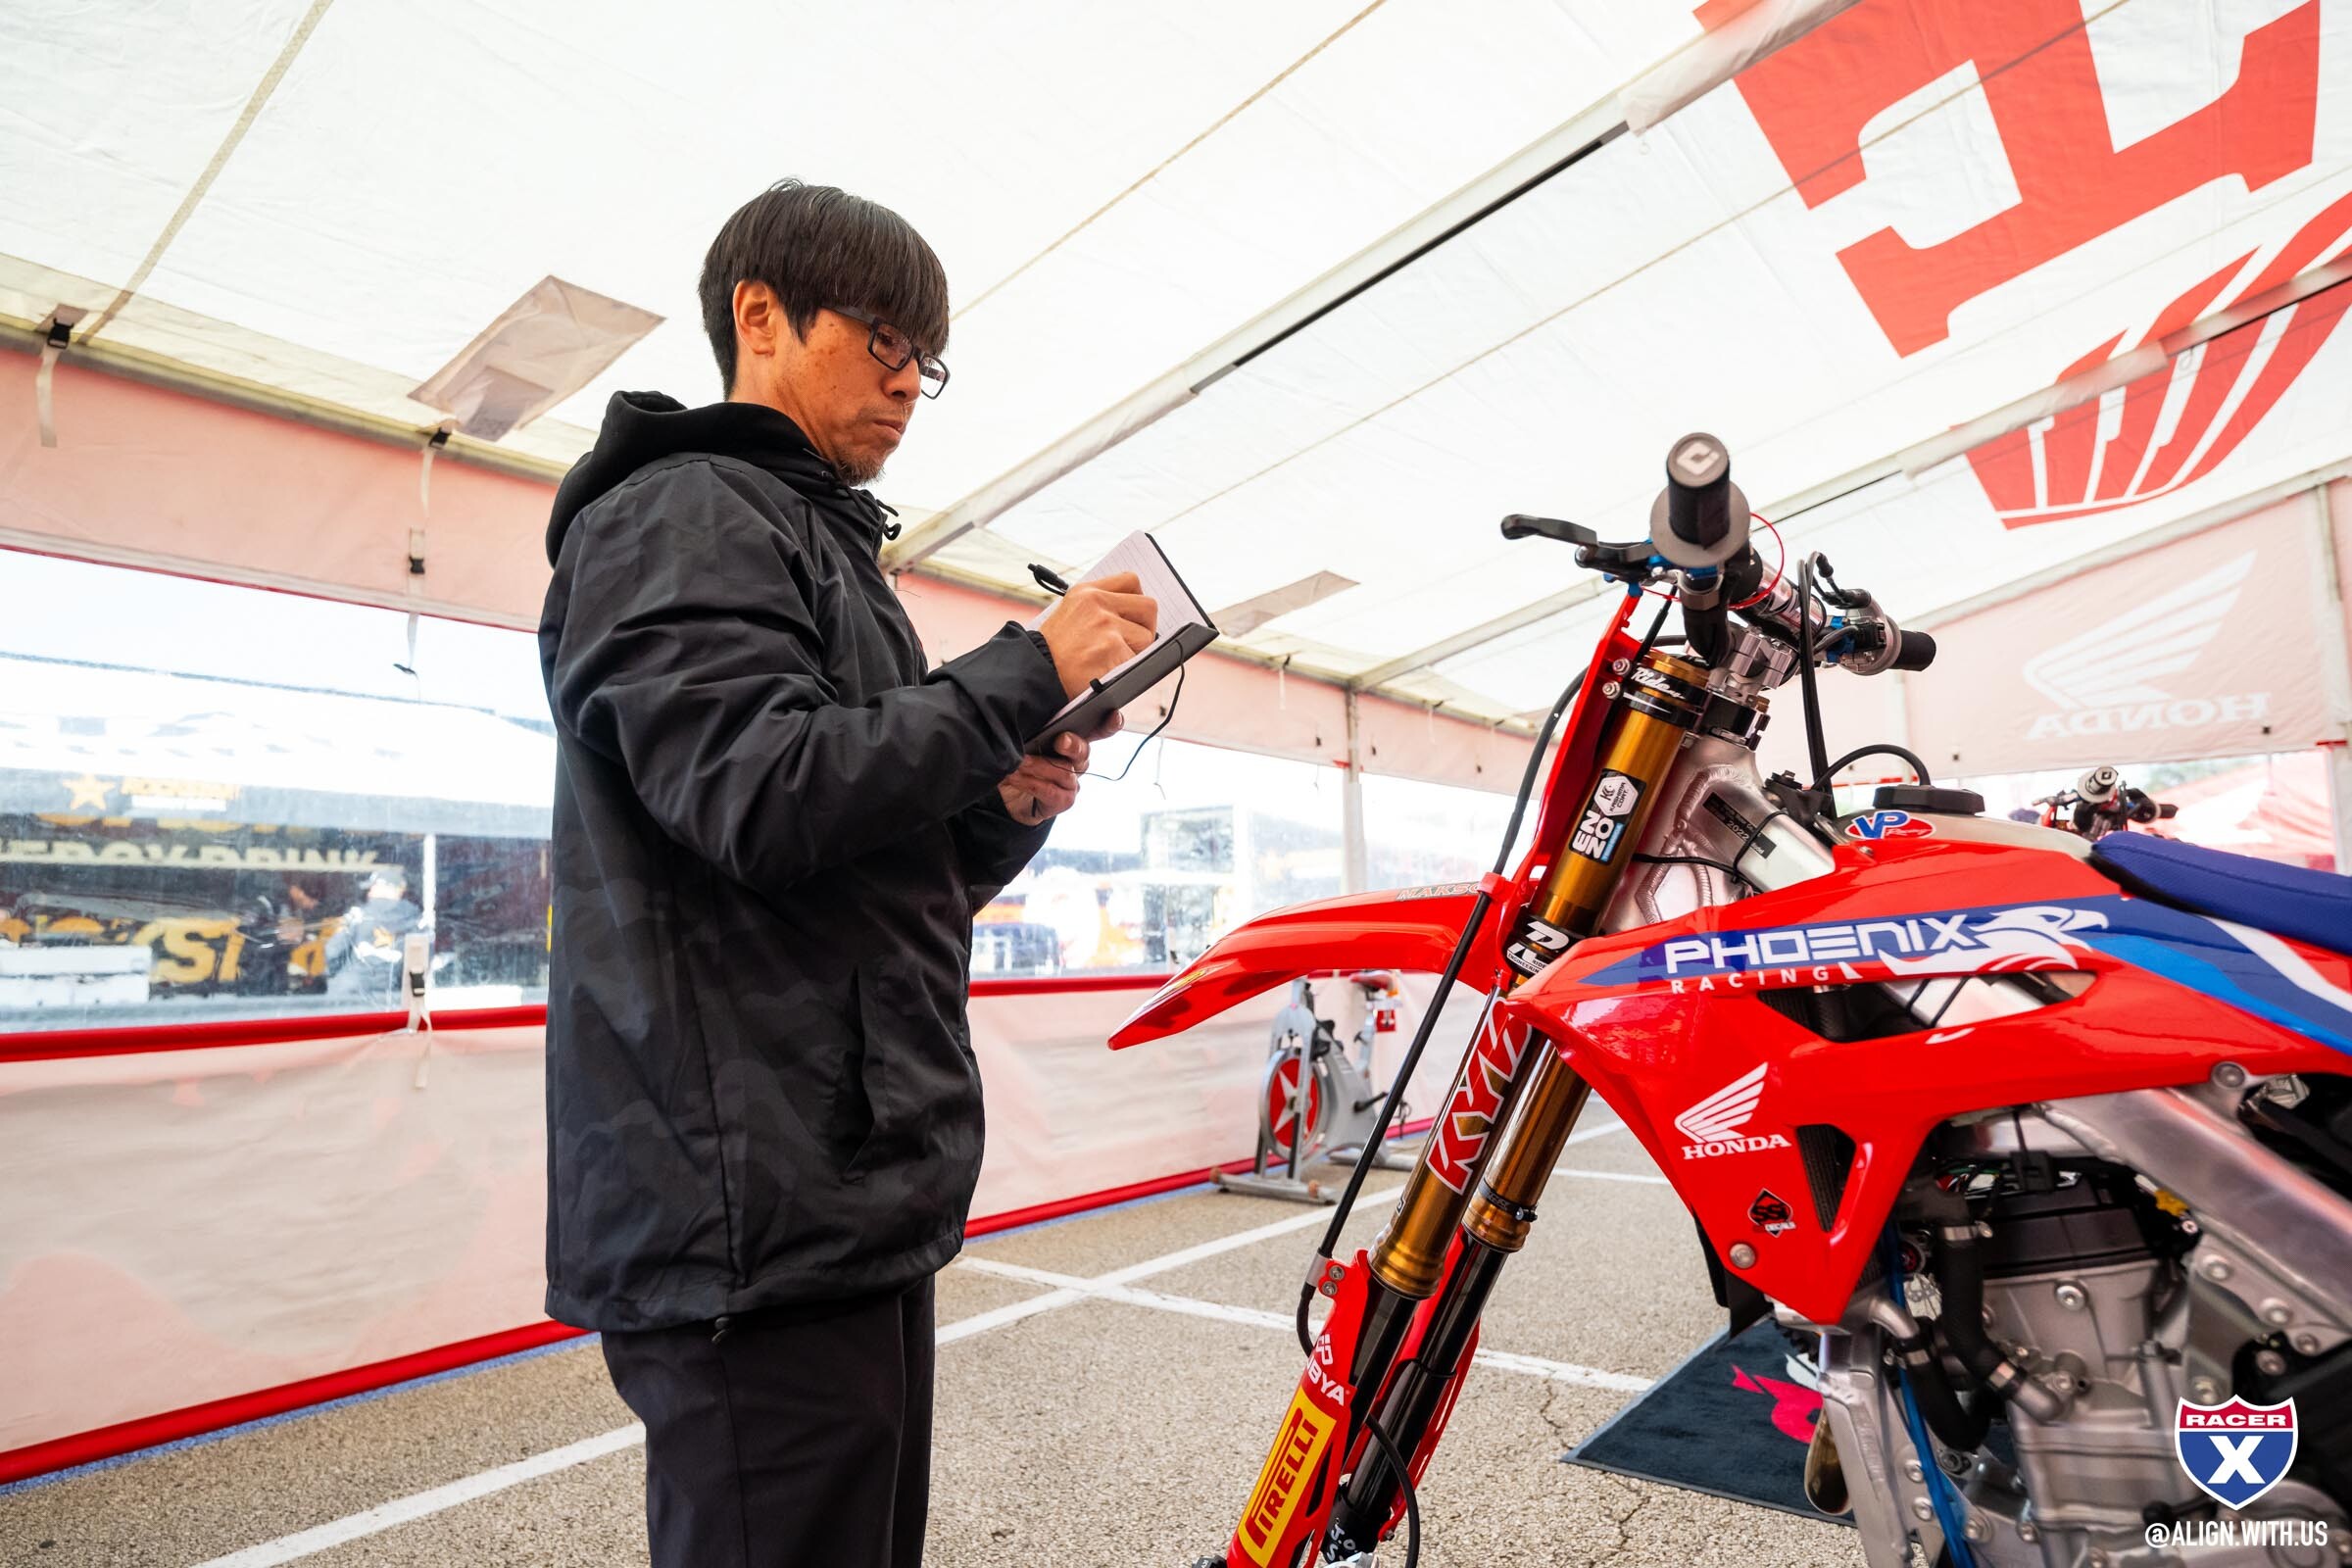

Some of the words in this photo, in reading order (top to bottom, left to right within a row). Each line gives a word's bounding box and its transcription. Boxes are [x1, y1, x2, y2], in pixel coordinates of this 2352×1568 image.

[1727, 820, 1749, 841] 2022
[1852, 810, 1909, 840] VP
[1665, 913, 1979, 974] PHOENIX
[1508, 953, 1541, 974] ENGINEERIN
[1671, 966, 1830, 995] RACING
[1682, 1134, 1792, 1160] HONDA
[1245, 1407, 1319, 1550] PIRELLI
